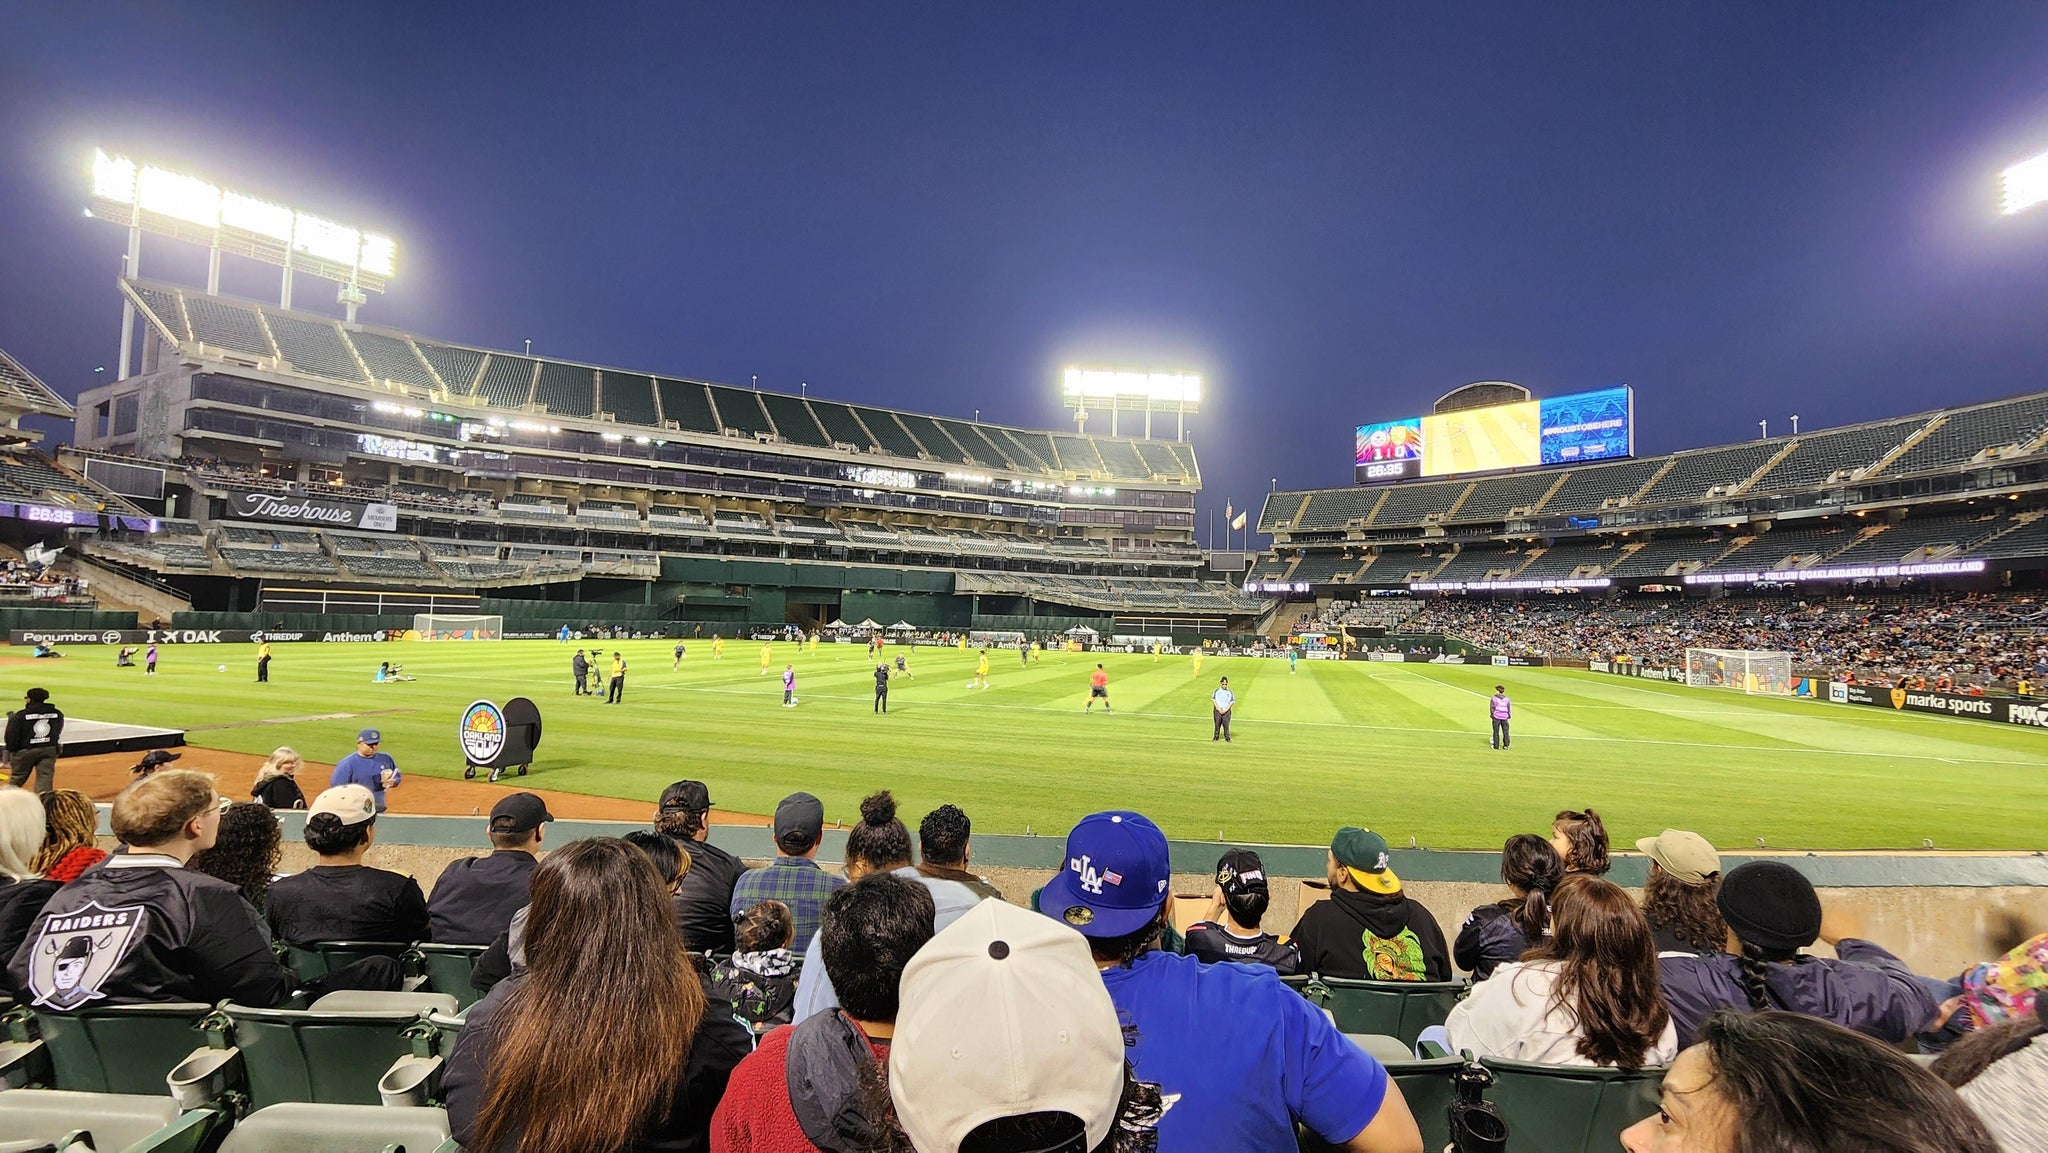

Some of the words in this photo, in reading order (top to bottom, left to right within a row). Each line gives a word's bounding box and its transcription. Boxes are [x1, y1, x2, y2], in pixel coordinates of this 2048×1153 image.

[1374, 448, 1383, 459] 1
[1394, 446, 1405, 458] 0
[238, 493, 352, 522] Treehouse
[1697, 575, 1724, 583] SOCIAL
[1724, 574, 1746, 582] WITH
[1747, 573, 1759, 581] US
[1765, 572, 1798, 580] FOLLOW
[1877, 566, 1898, 576] AND
[23, 632, 97, 642] Penumbra
[183, 630, 220, 643] OAK
[264, 633, 303, 641] THREDUP
[322, 632, 372, 643] Anthem
[1288, 636, 1338, 646] FAIRYLAND
[1090, 645, 1124, 653] Anthem
[1162, 646, 1182, 654] OAK
[1243, 648, 1263, 659] UCSF
[1306, 650, 1340, 660] ESPN
[1641, 667, 1662, 680] Anthem
[1906, 693, 1946, 708] marka
[1948, 699, 1992, 714] sports
[2009, 704, 2039, 720] FOX
[464, 730, 501, 743] OAKLAND
[464, 740, 500, 758] SOUL
[1080, 854, 1102, 895] LA
[50, 912, 128, 932] RAIDERS
[1224, 943, 1257, 955] THREDUP
